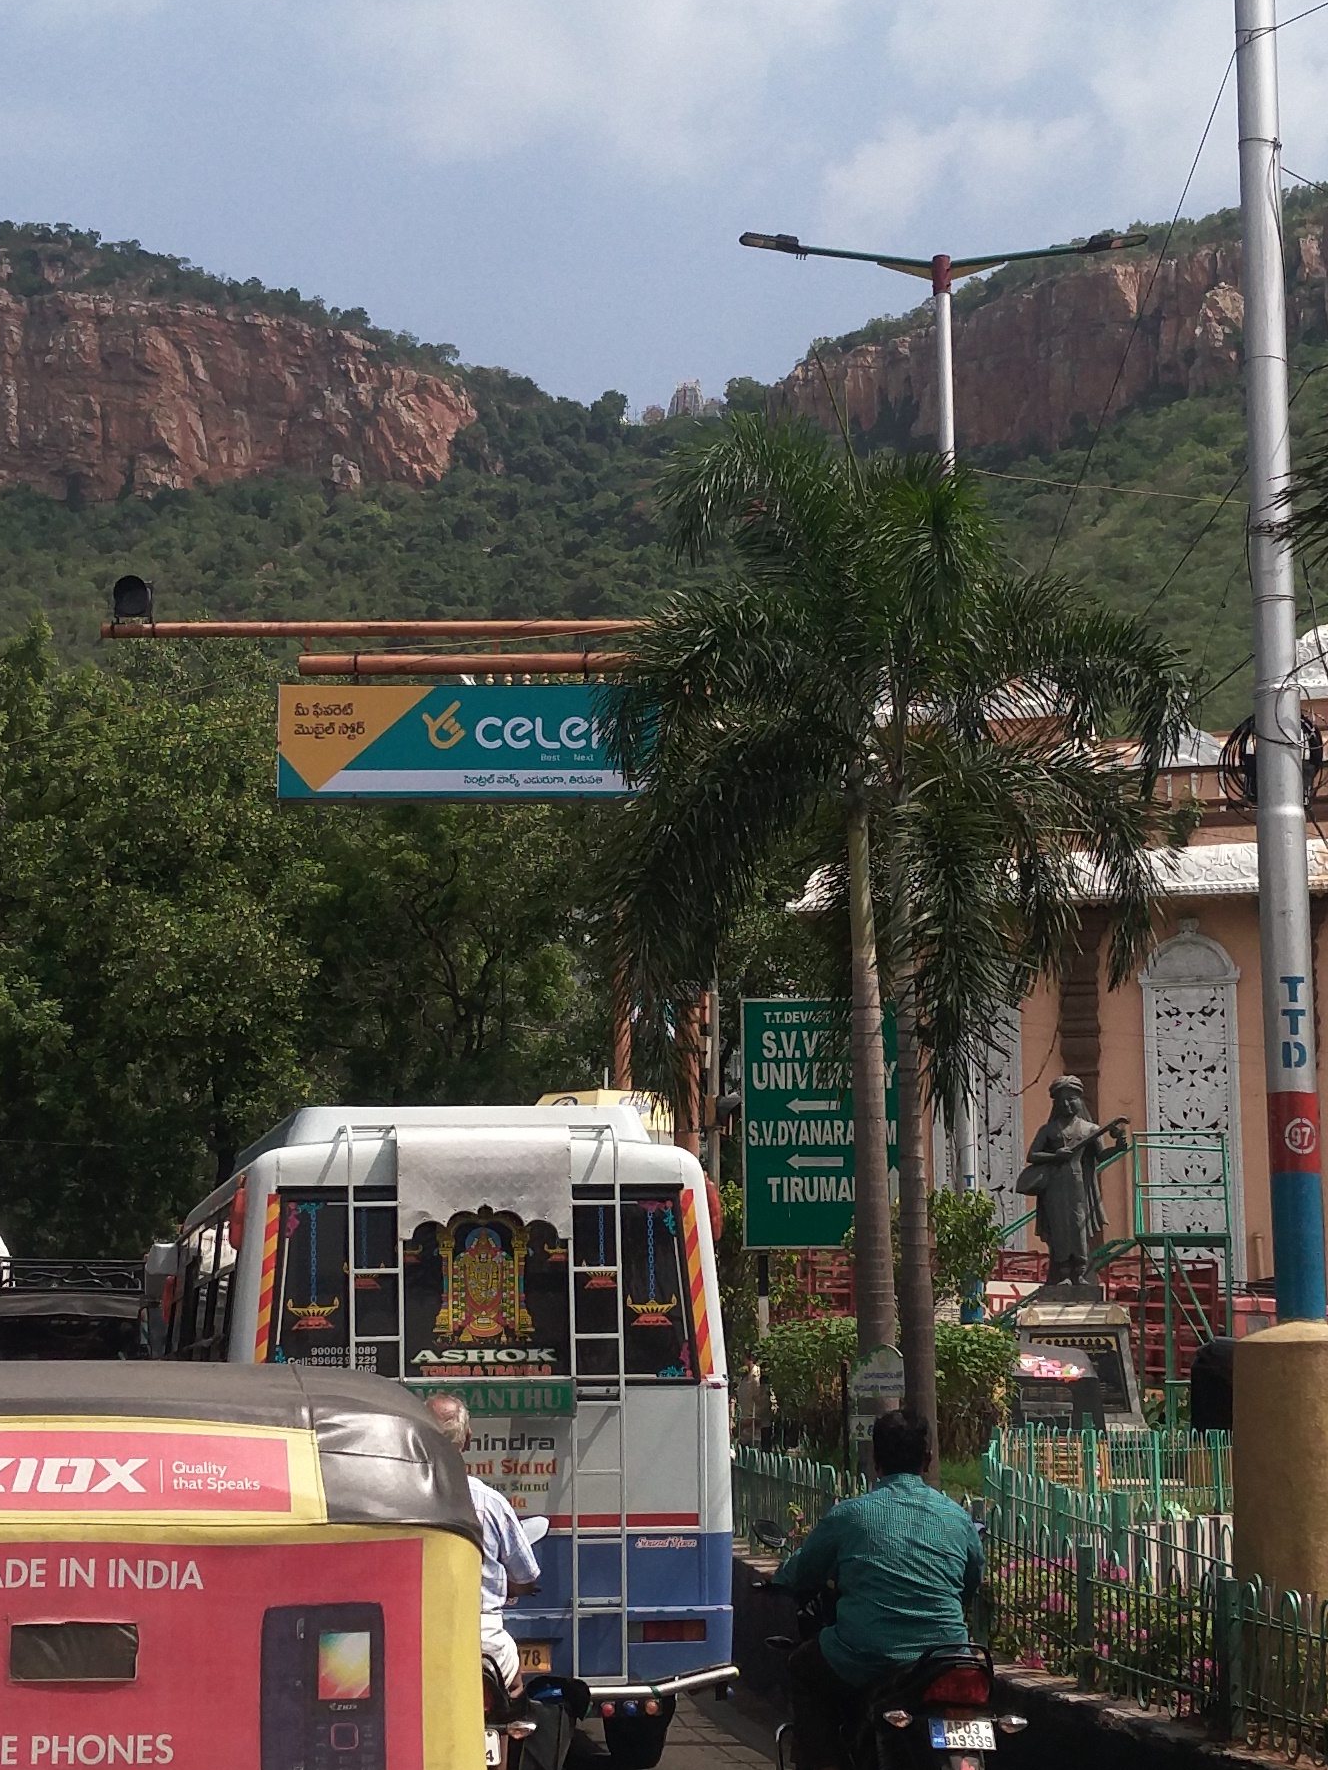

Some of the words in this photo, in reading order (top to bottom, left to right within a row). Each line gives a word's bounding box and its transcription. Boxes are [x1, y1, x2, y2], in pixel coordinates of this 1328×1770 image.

[748, 1119, 897, 1146] S.V.DYANARAM
[1291, 1126, 1310, 1147] 97
[410, 1348, 557, 1363] ASHOK
[420, 1365, 471, 1377] TOURS
[472, 1365, 484, 1376] &
[486, 1364, 552, 1377] TRAVELS
[172, 1460, 228, 1478] Quality
[501, 1457, 558, 1476] Stand
[172, 1477, 204, 1491] that
[207, 1476, 261, 1492] Speaks
[58, 1557, 96, 1589] IN
[108, 1558, 204, 1590] INDIA
[30, 1734, 174, 1765] PHONES
